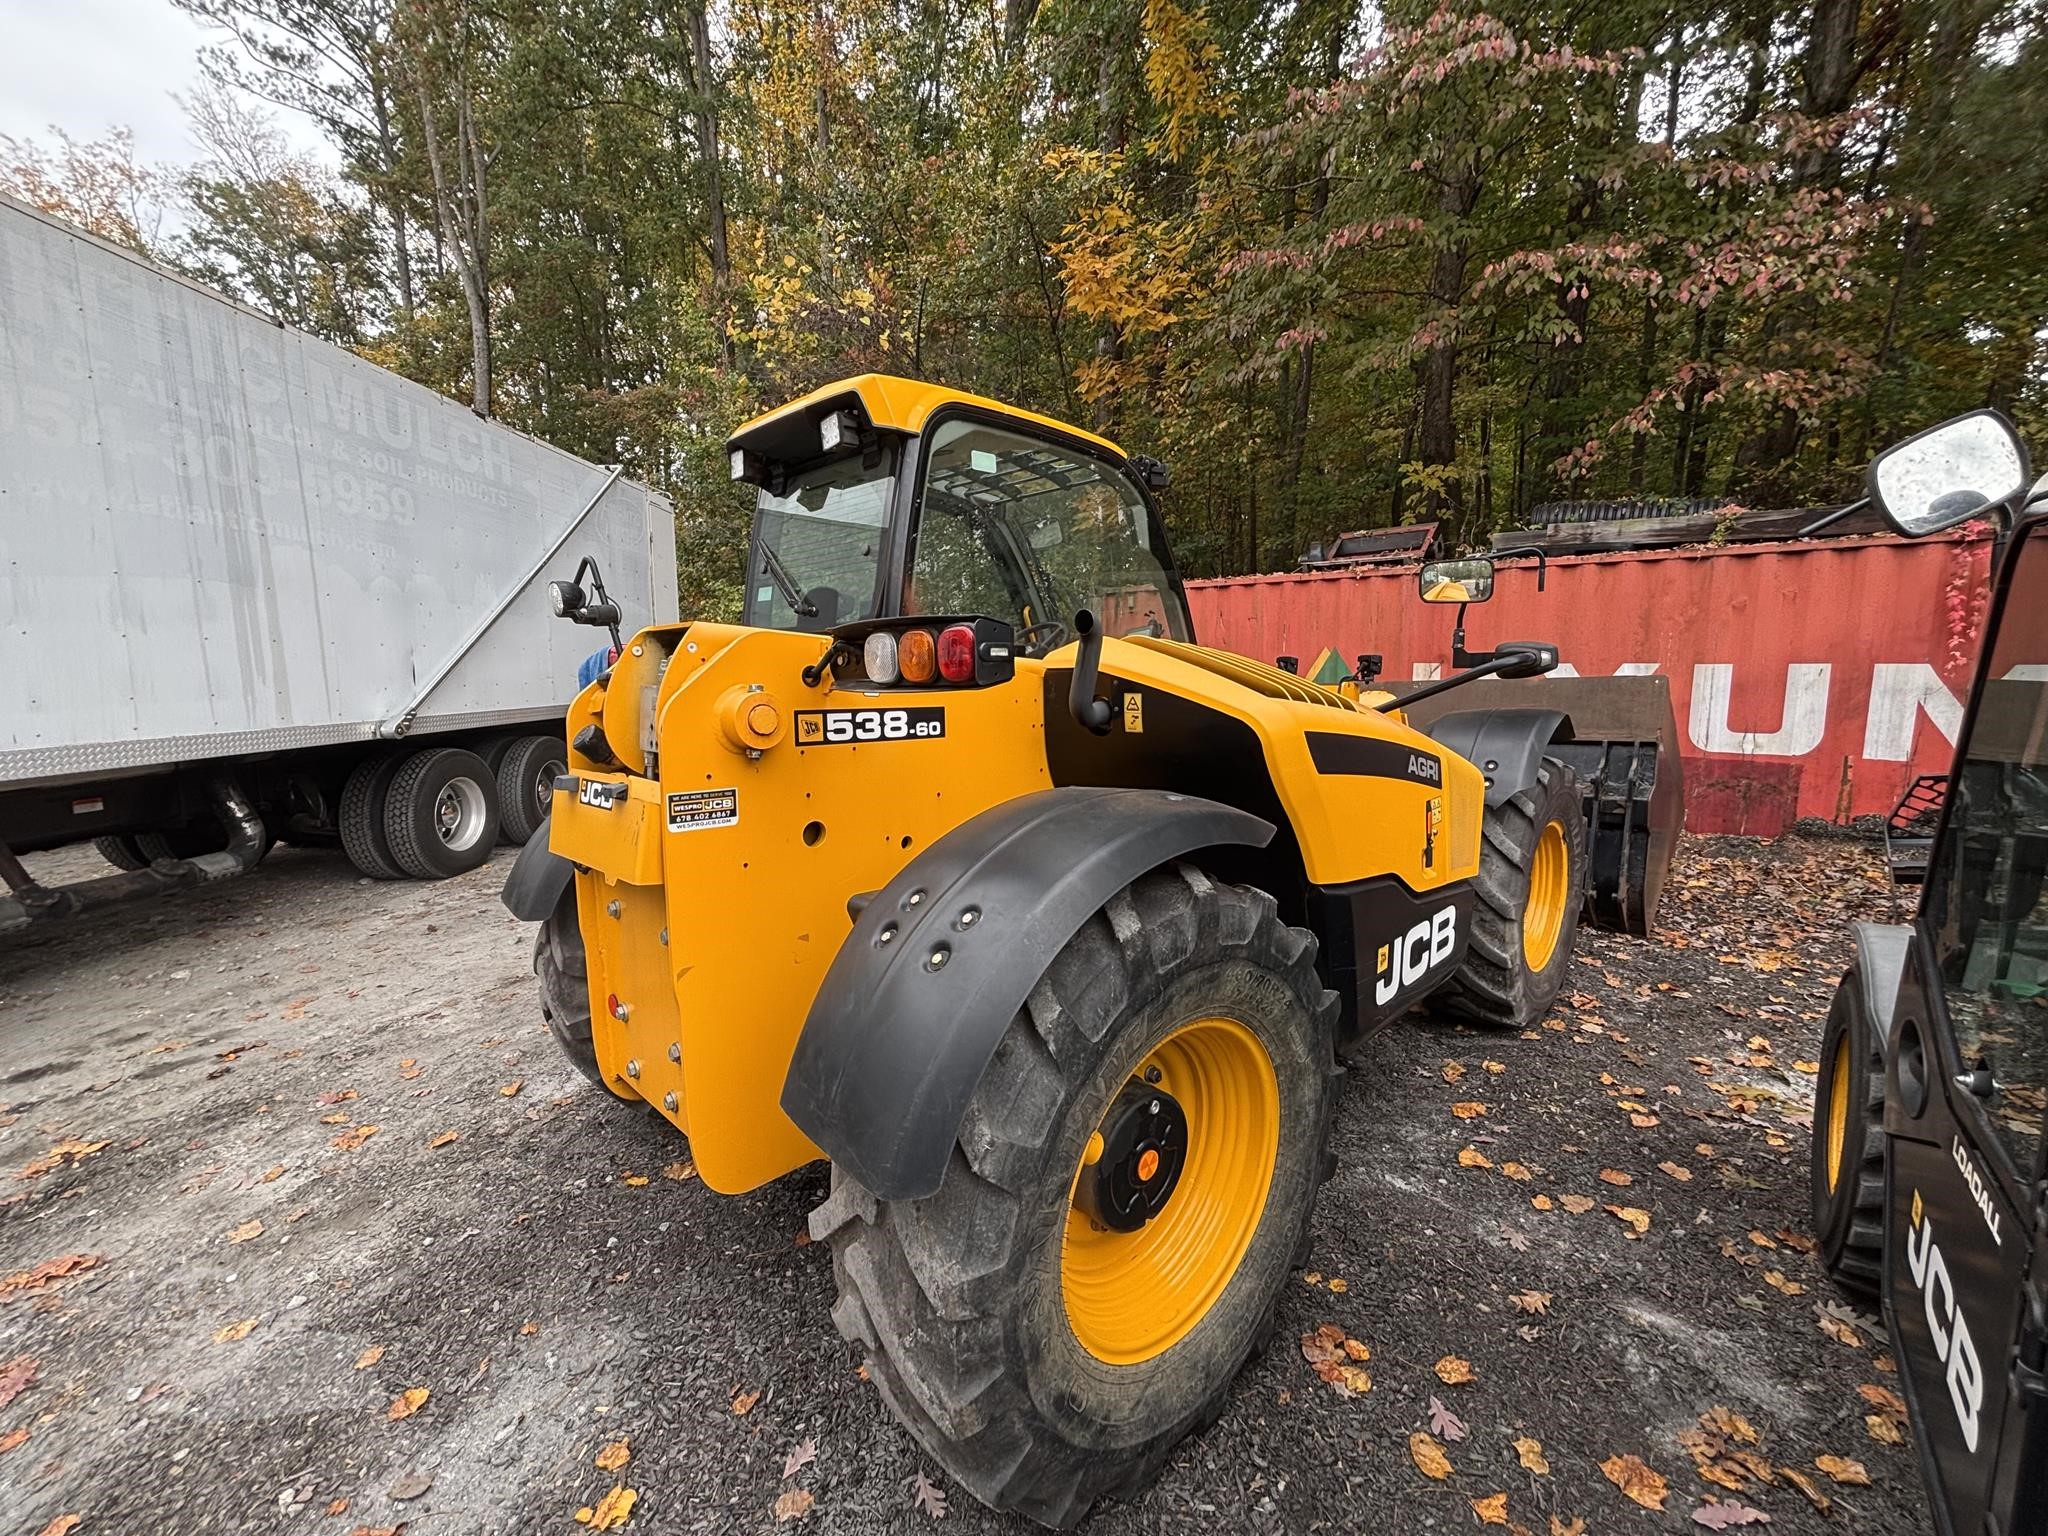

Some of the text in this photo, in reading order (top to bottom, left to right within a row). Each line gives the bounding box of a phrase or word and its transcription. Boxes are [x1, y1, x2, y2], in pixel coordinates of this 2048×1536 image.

[309, 354, 511, 488] MULCH
[674, 799, 733, 811] WESPRO JCB
[1408, 754, 1439, 782] AGRI
[1373, 902, 1456, 1006] JCB
[1952, 1135, 2001, 1246] LOADALL
[1907, 1216, 1983, 1453] JCB
